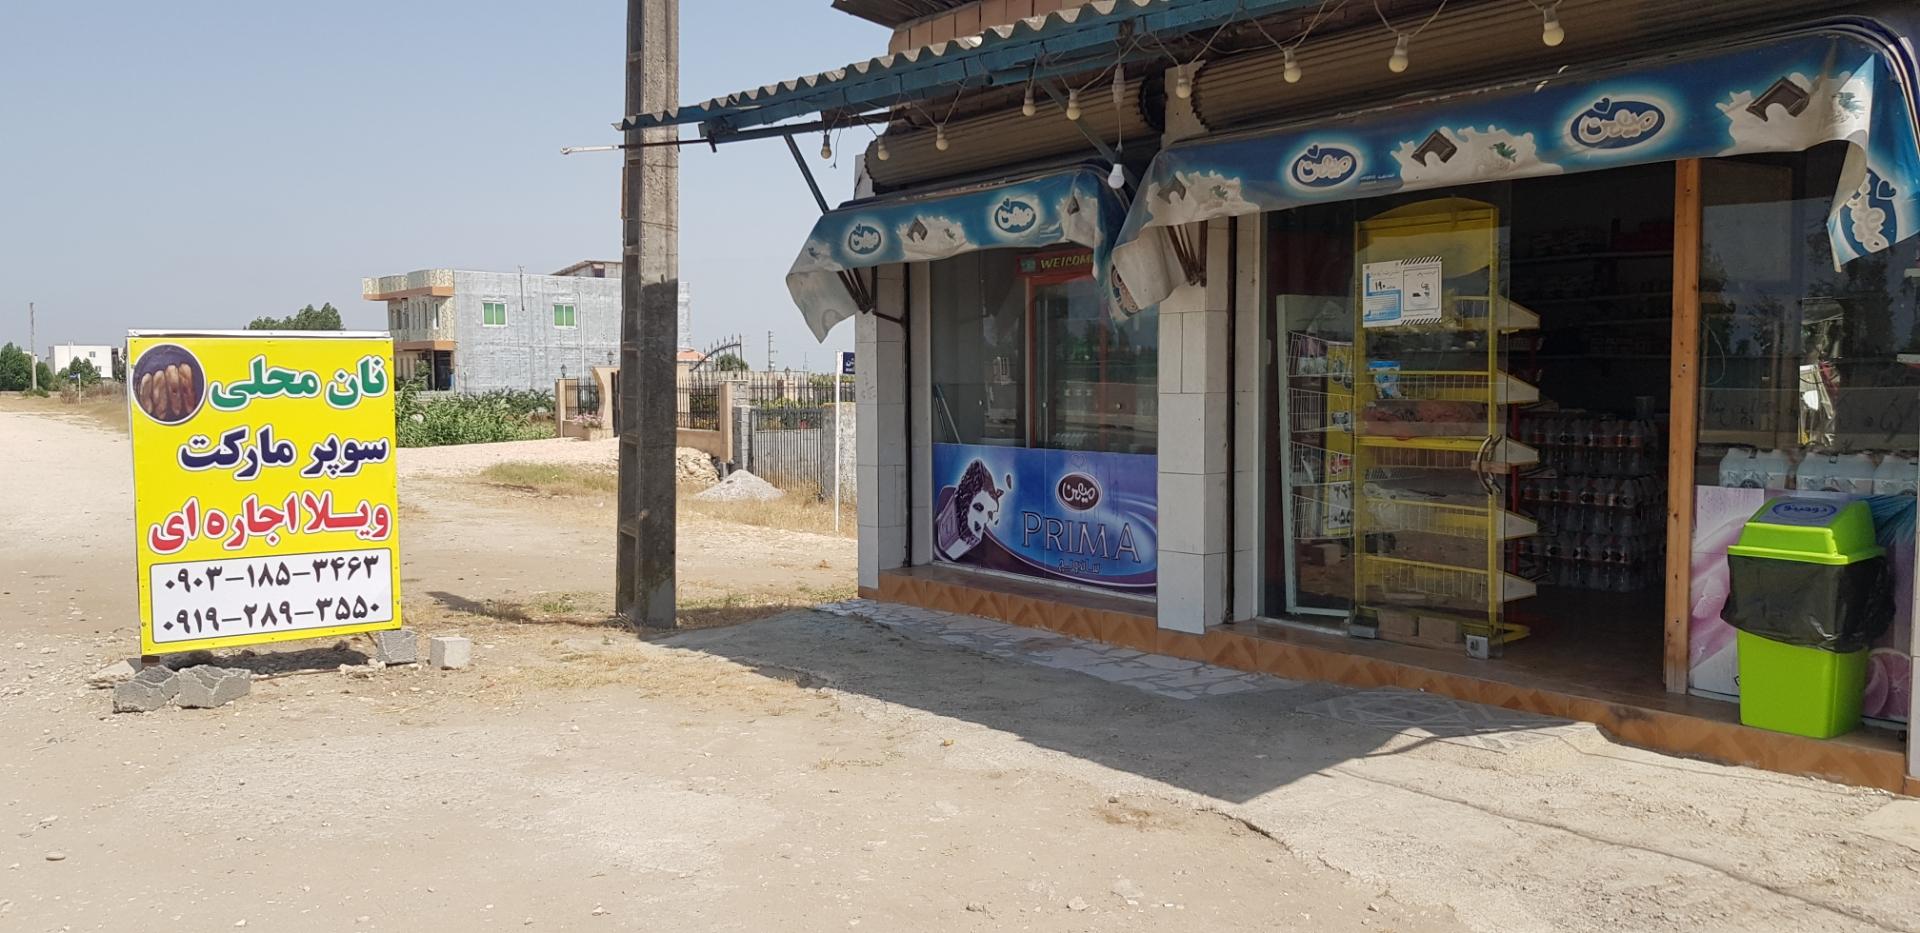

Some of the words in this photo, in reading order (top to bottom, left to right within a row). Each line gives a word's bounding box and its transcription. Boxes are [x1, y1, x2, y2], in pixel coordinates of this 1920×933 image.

[1579, 109, 1659, 143] میهن
[1297, 154, 1352, 183] میهن
[1041, 255, 1094, 269] WELCOM
[212, 358, 317, 407] محلی
[328, 358, 385, 406] نان
[182, 428, 293, 477] مارکت
[304, 438, 387, 476] سوپر
[1063, 483, 1095, 503] میهن
[152, 502, 196, 550] ای
[207, 496, 297, 547] اجاره
[305, 494, 388, 537] ویلا
[1021, 511, 1141, 563] PRIMA
[165, 555, 379, 593] ۰۹۰۳-۱۸۵-۳۴۶۳
[163, 594, 380, 634] ۰۹۱۹-۲۸۹-۳۵۵۰
